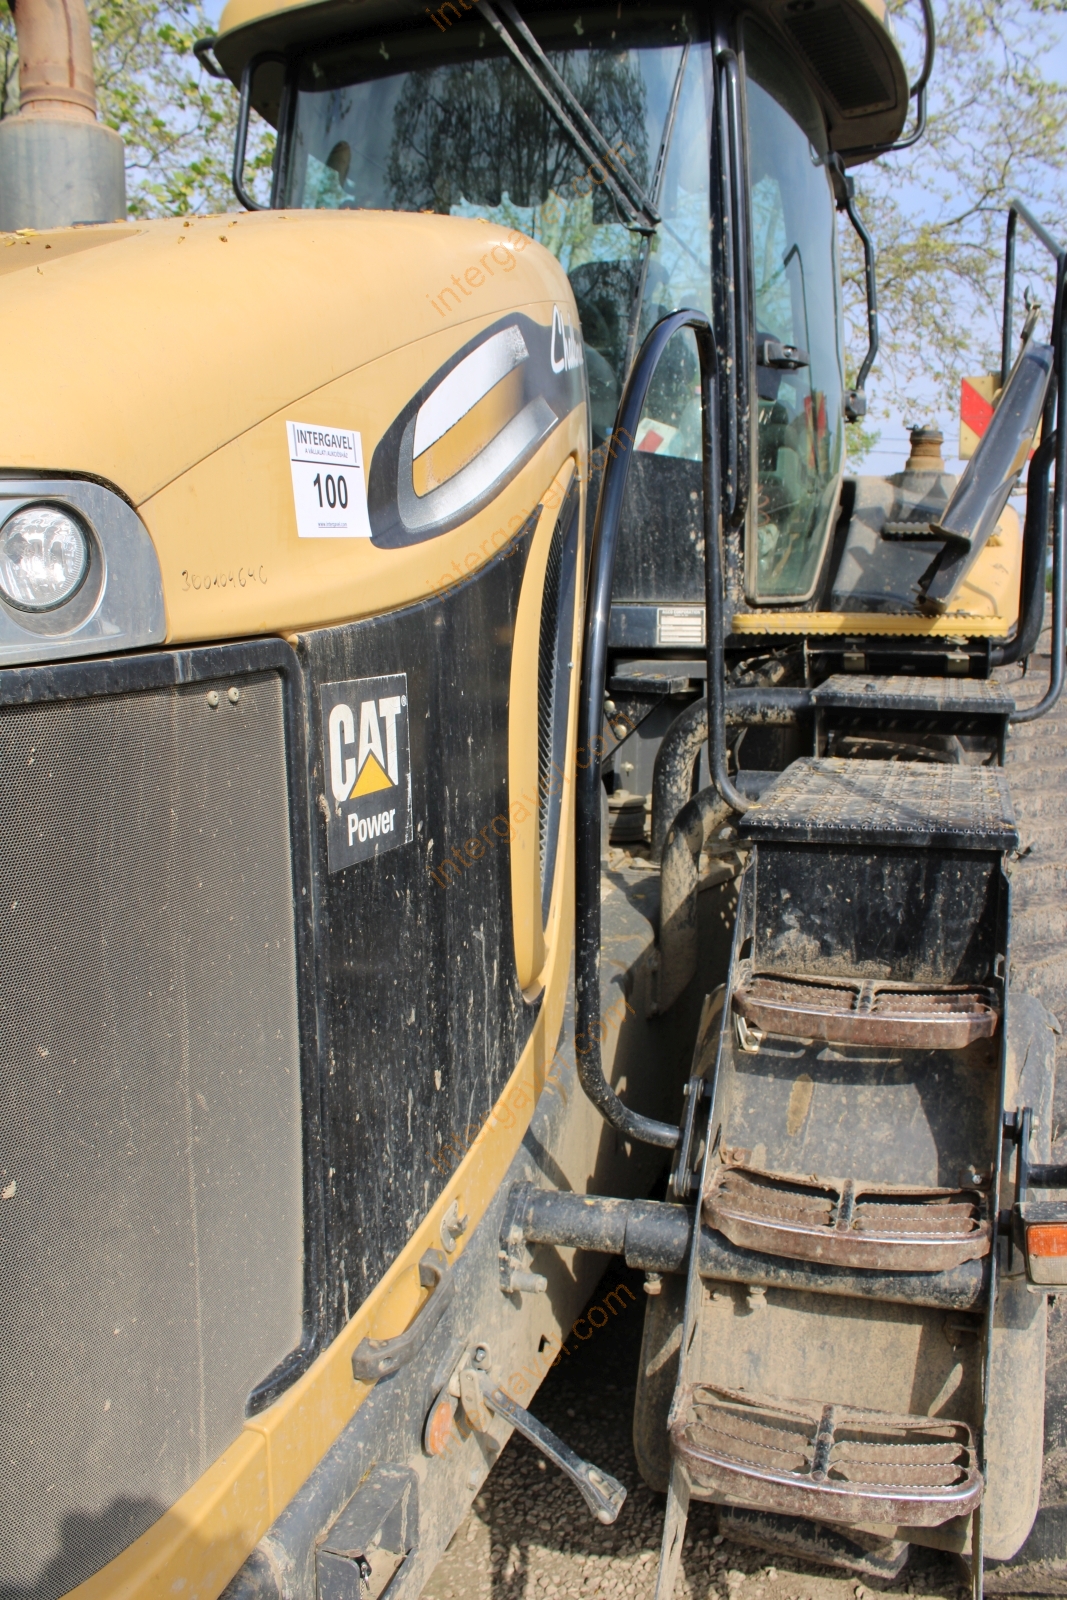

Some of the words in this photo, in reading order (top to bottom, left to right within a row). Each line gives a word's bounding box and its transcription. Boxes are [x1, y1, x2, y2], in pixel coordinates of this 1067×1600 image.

[296, 429, 353, 450] INTERGAVEL
[313, 473, 348, 509] 100
[329, 696, 402, 802] CAT
[347, 808, 396, 847] Power
